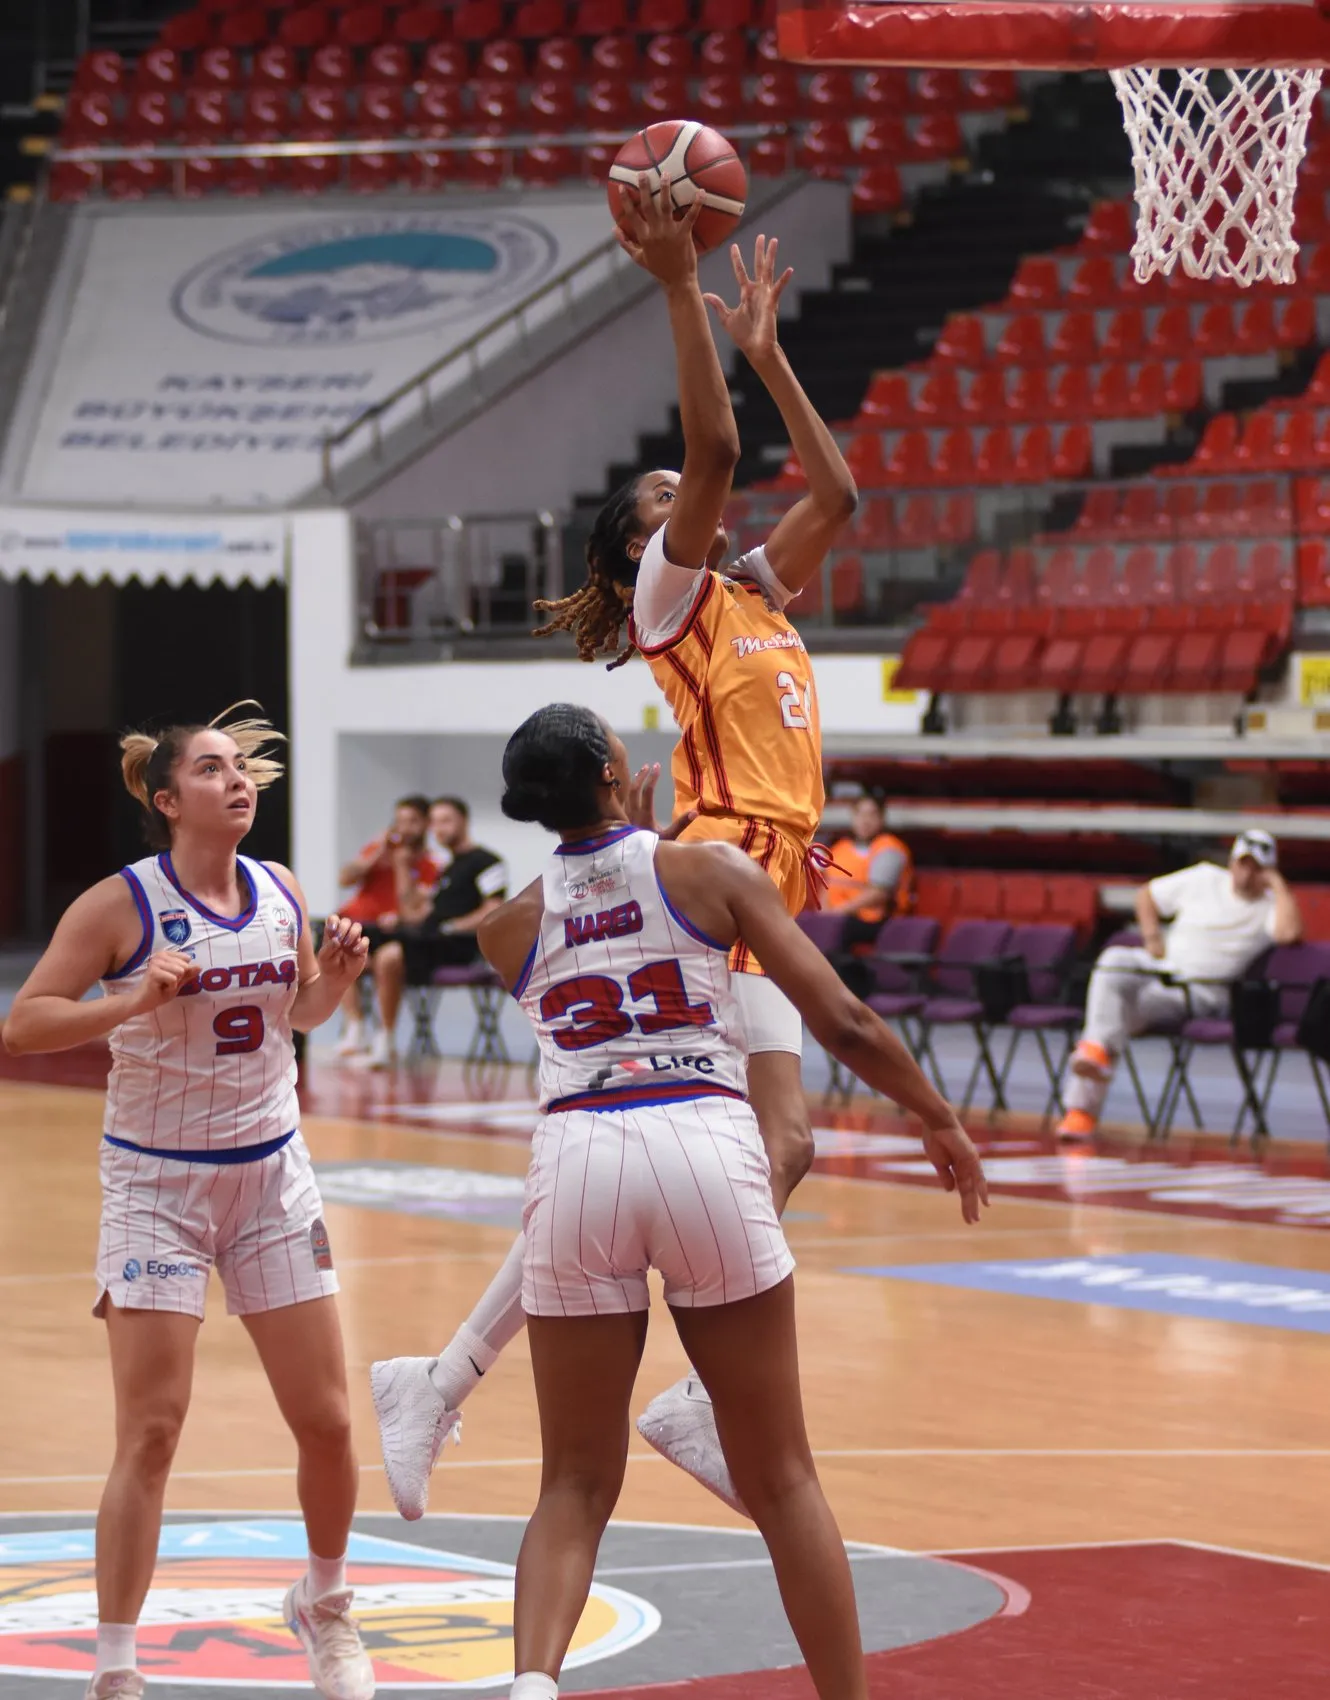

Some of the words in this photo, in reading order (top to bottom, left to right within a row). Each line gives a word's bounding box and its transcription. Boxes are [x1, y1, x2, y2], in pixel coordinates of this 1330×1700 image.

[564, 899, 643, 949] NARED
[540, 958, 717, 1051] 31
[213, 1005, 264, 1056] 9
